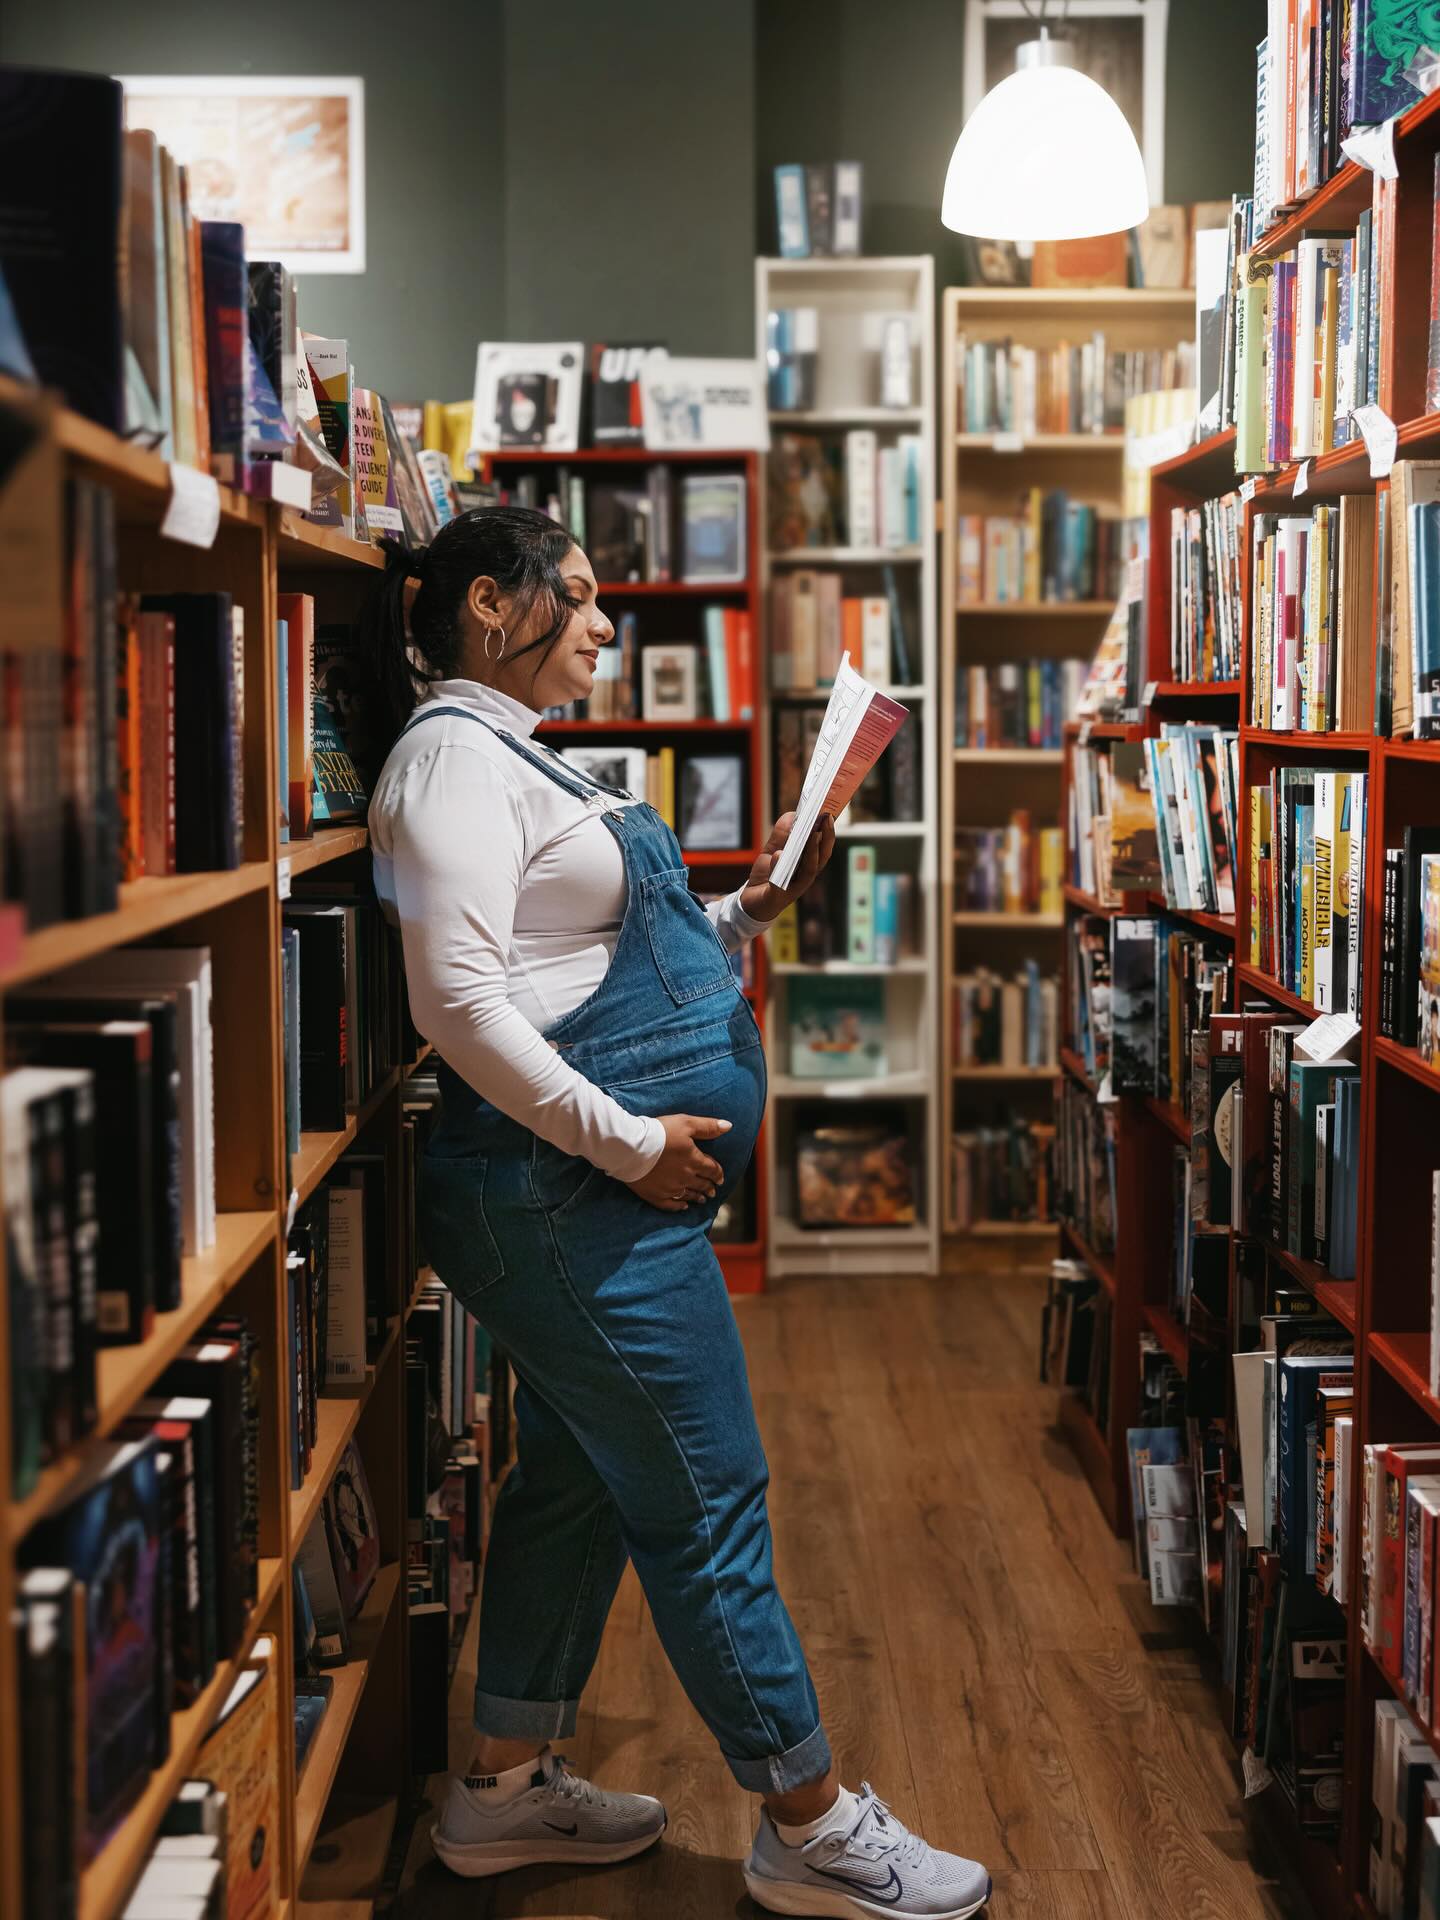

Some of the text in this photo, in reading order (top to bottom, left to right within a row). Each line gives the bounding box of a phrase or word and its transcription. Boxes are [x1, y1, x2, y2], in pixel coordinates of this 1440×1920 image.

[354, 406, 371, 421] ANS
[355, 443, 376, 457] TEEN
[360, 479, 384, 495] GUIDE
[1314, 836, 1332, 949] INVINCIBLE
[1349, 838, 1359, 954] INVINCIBLE
[1271, 1098, 1282, 1200] SWEET TOOTH
[464, 1776, 497, 1788] UMA
